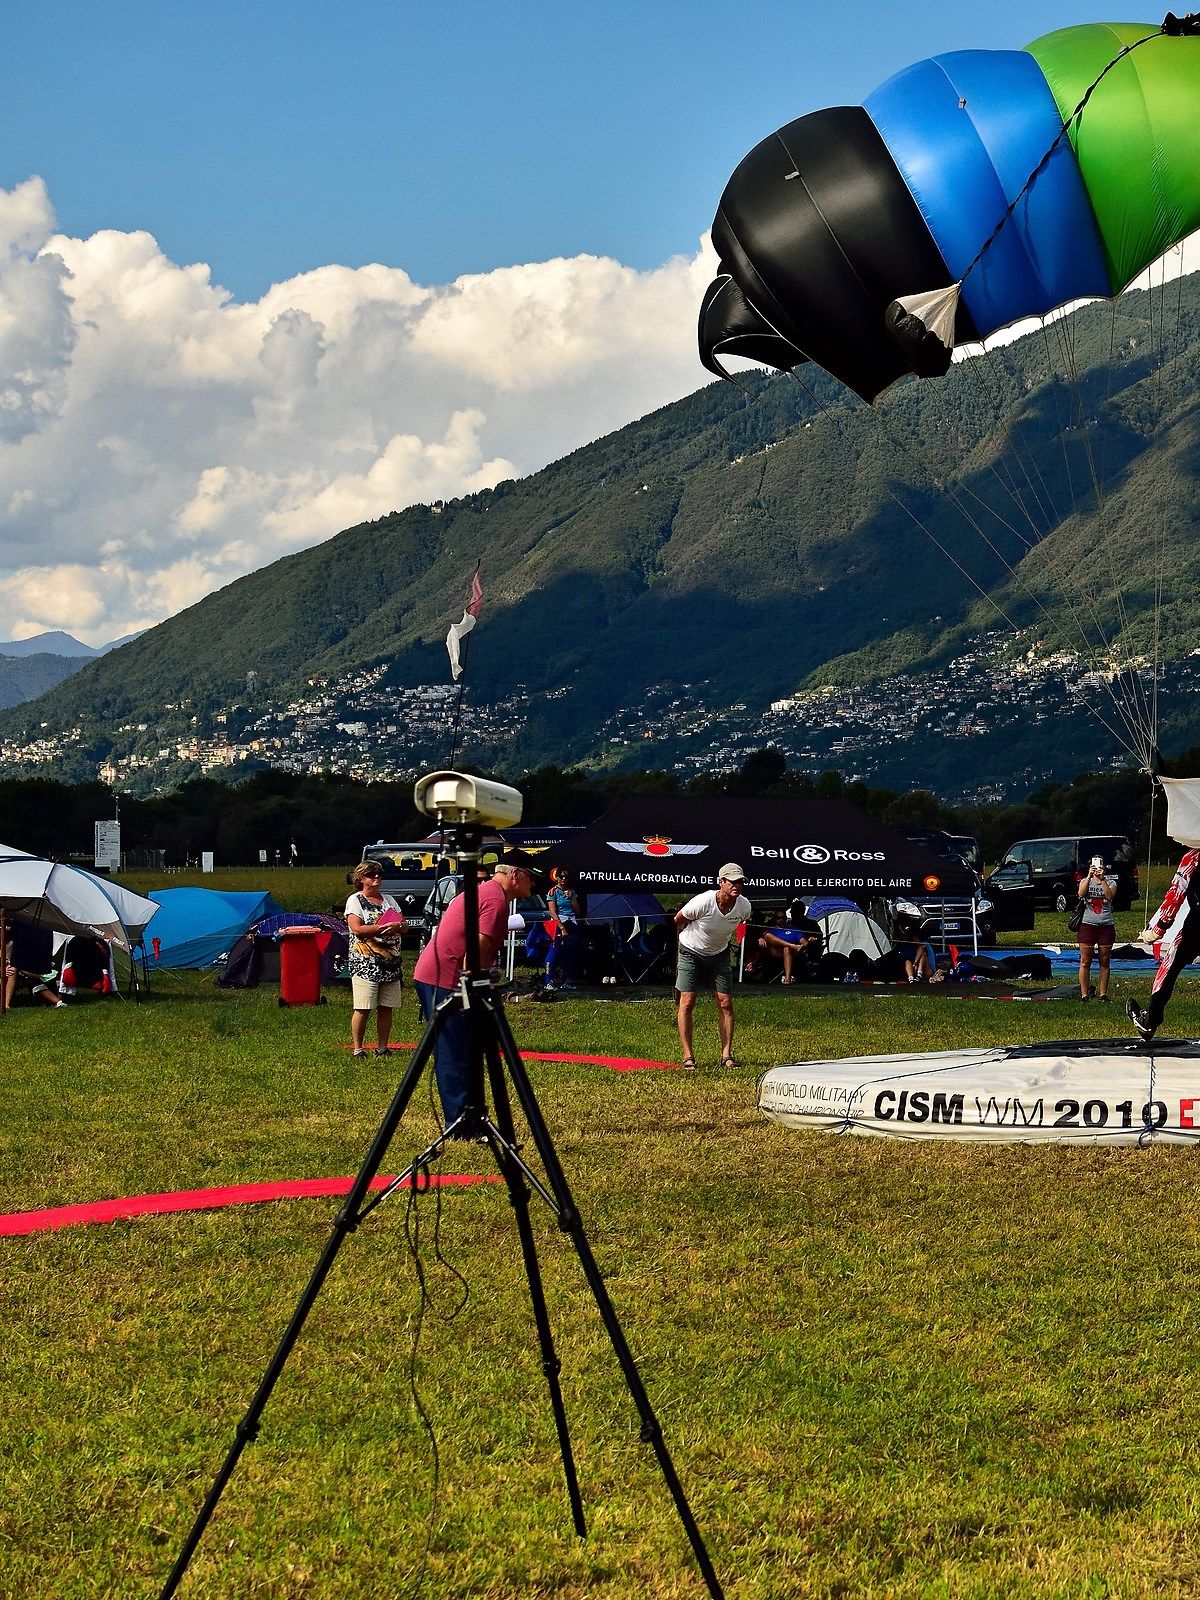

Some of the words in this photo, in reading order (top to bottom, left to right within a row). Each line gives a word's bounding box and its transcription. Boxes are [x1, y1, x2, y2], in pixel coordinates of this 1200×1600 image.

[751, 846, 790, 859] Bell
[834, 850, 886, 861] Ross
[579, 871, 631, 882] PATRULLA
[634, 873, 697, 884] ACROBATICA
[700, 876, 714, 885] DE
[794, 878, 814, 888] DEL
[816, 878, 864, 888] EJERCITO
[867, 878, 886, 888] DEL
[889, 878, 912, 888] AIRE
[776, 1082, 807, 1099] WORLD
[809, 1085, 869, 1104] MILITARY
[874, 1090, 965, 1124] CISM
[975, 1096, 1044, 1126] WM
[1054, 1099, 1168, 1129] 2010
